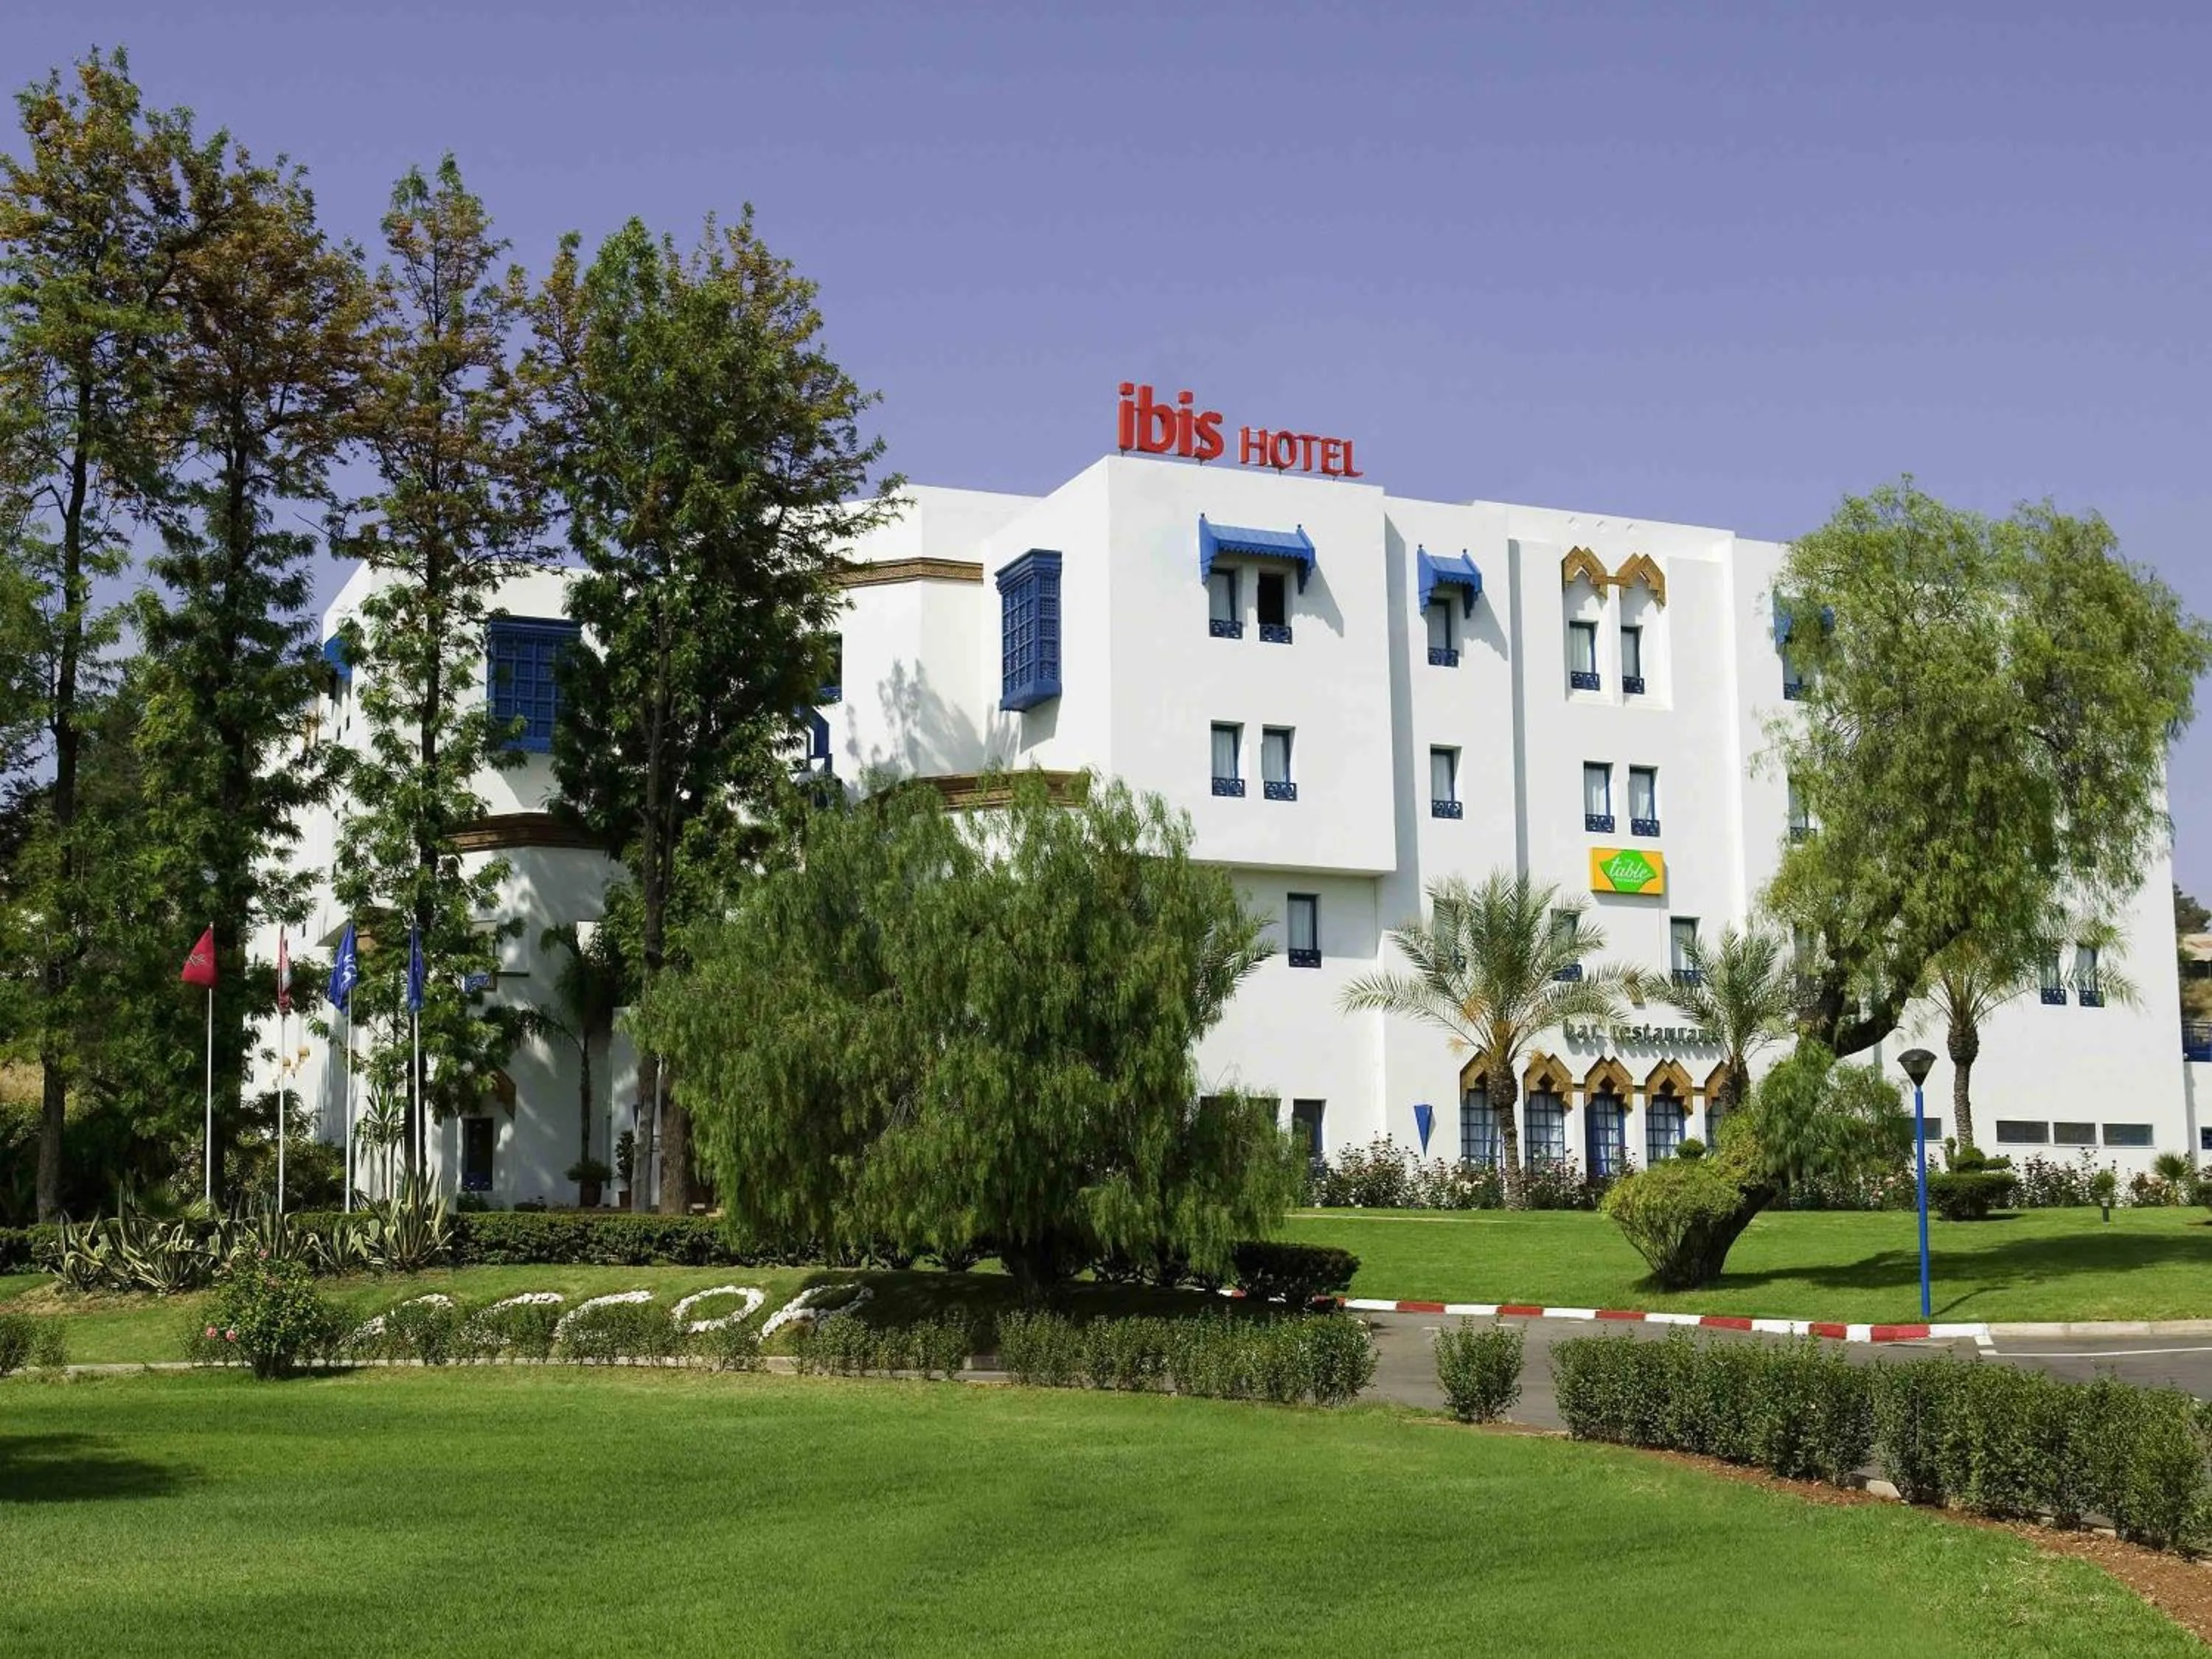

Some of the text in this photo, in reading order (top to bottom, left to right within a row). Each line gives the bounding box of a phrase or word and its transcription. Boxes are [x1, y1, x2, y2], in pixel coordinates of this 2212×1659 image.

[1118, 382, 1363, 477] ibis HOTEL
[1563, 1018, 1598, 1040] bar
